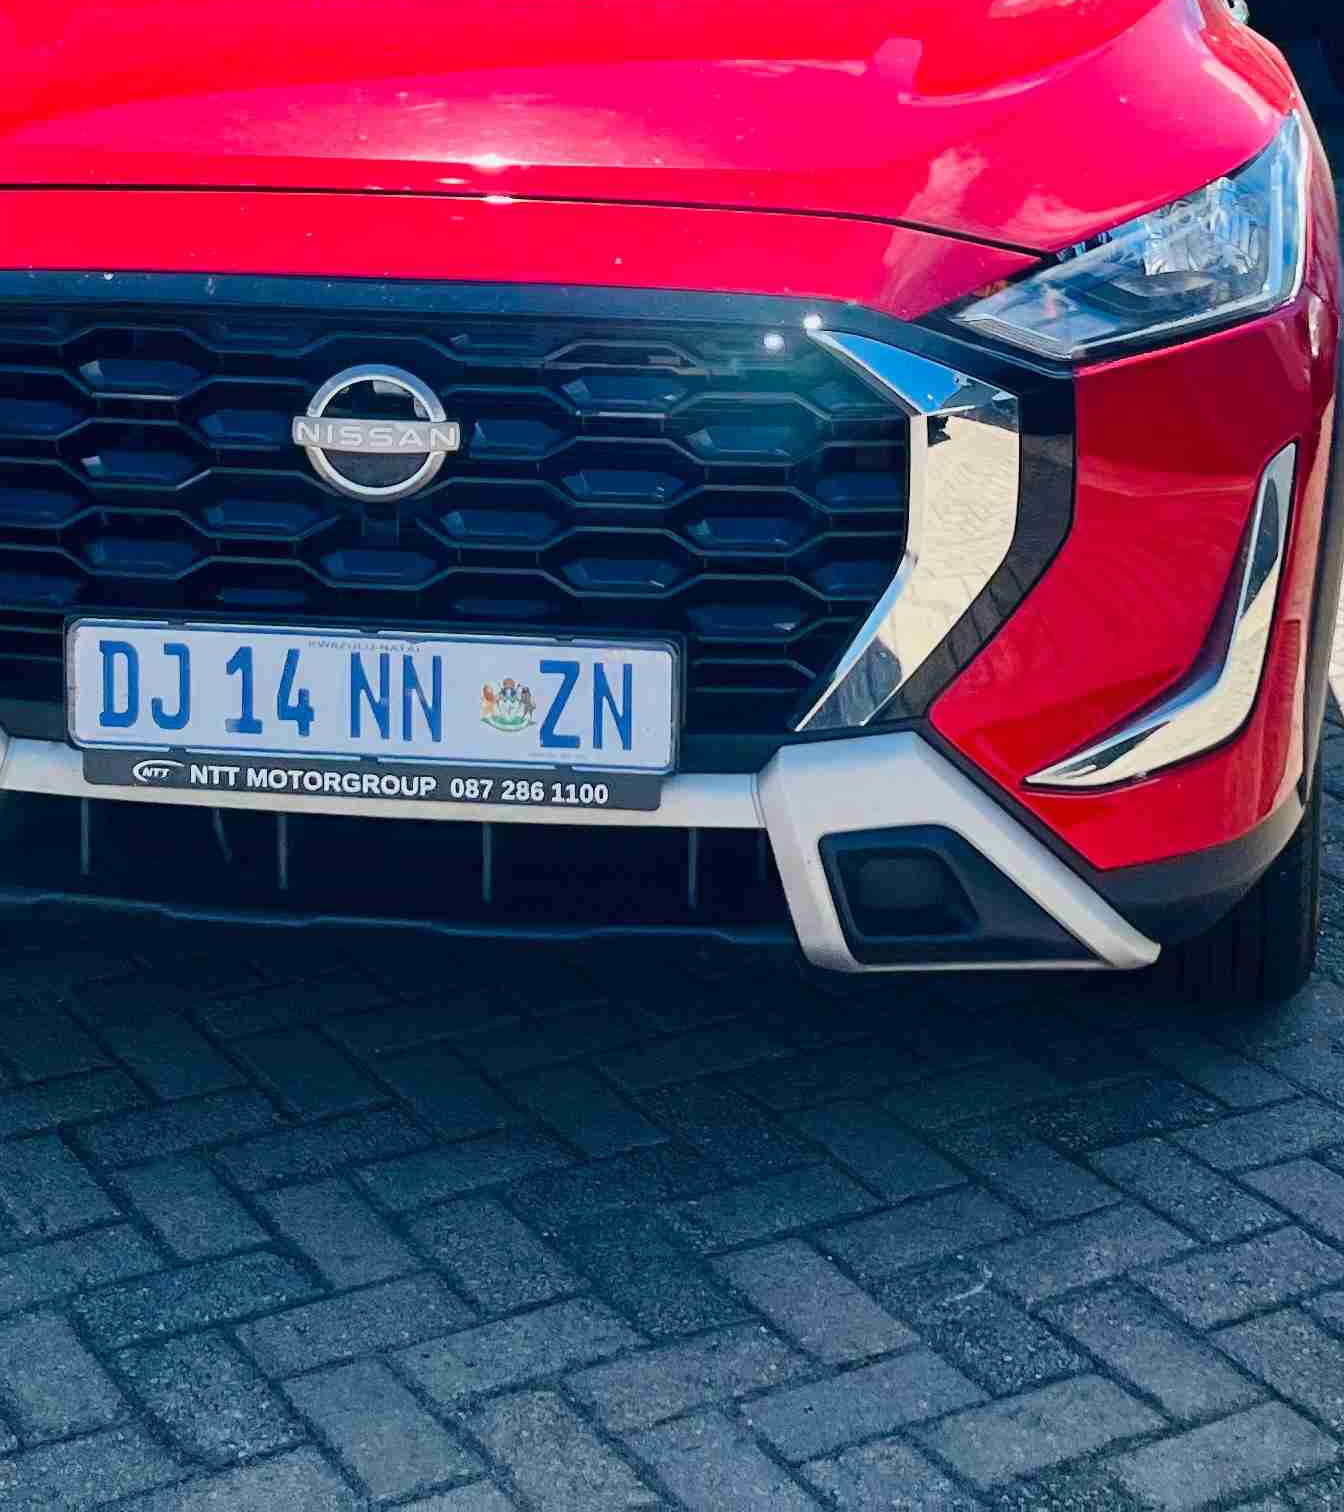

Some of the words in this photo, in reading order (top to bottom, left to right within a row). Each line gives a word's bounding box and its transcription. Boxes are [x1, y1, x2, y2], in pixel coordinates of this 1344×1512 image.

[297, 422, 456, 449] NISSAN
[98, 639, 191, 730] DJ
[225, 645, 316, 737] 14
[348, 652, 443, 743] NN
[539, 659, 633, 751] ZN
[142, 767, 170, 778] NTT
[190, 764, 240, 787] NTT
[246, 767, 438, 797] MOTORGROUP
[450, 779, 494, 799] 087
[500, 780, 545, 802] 286
[551, 782, 609, 805] 1100
